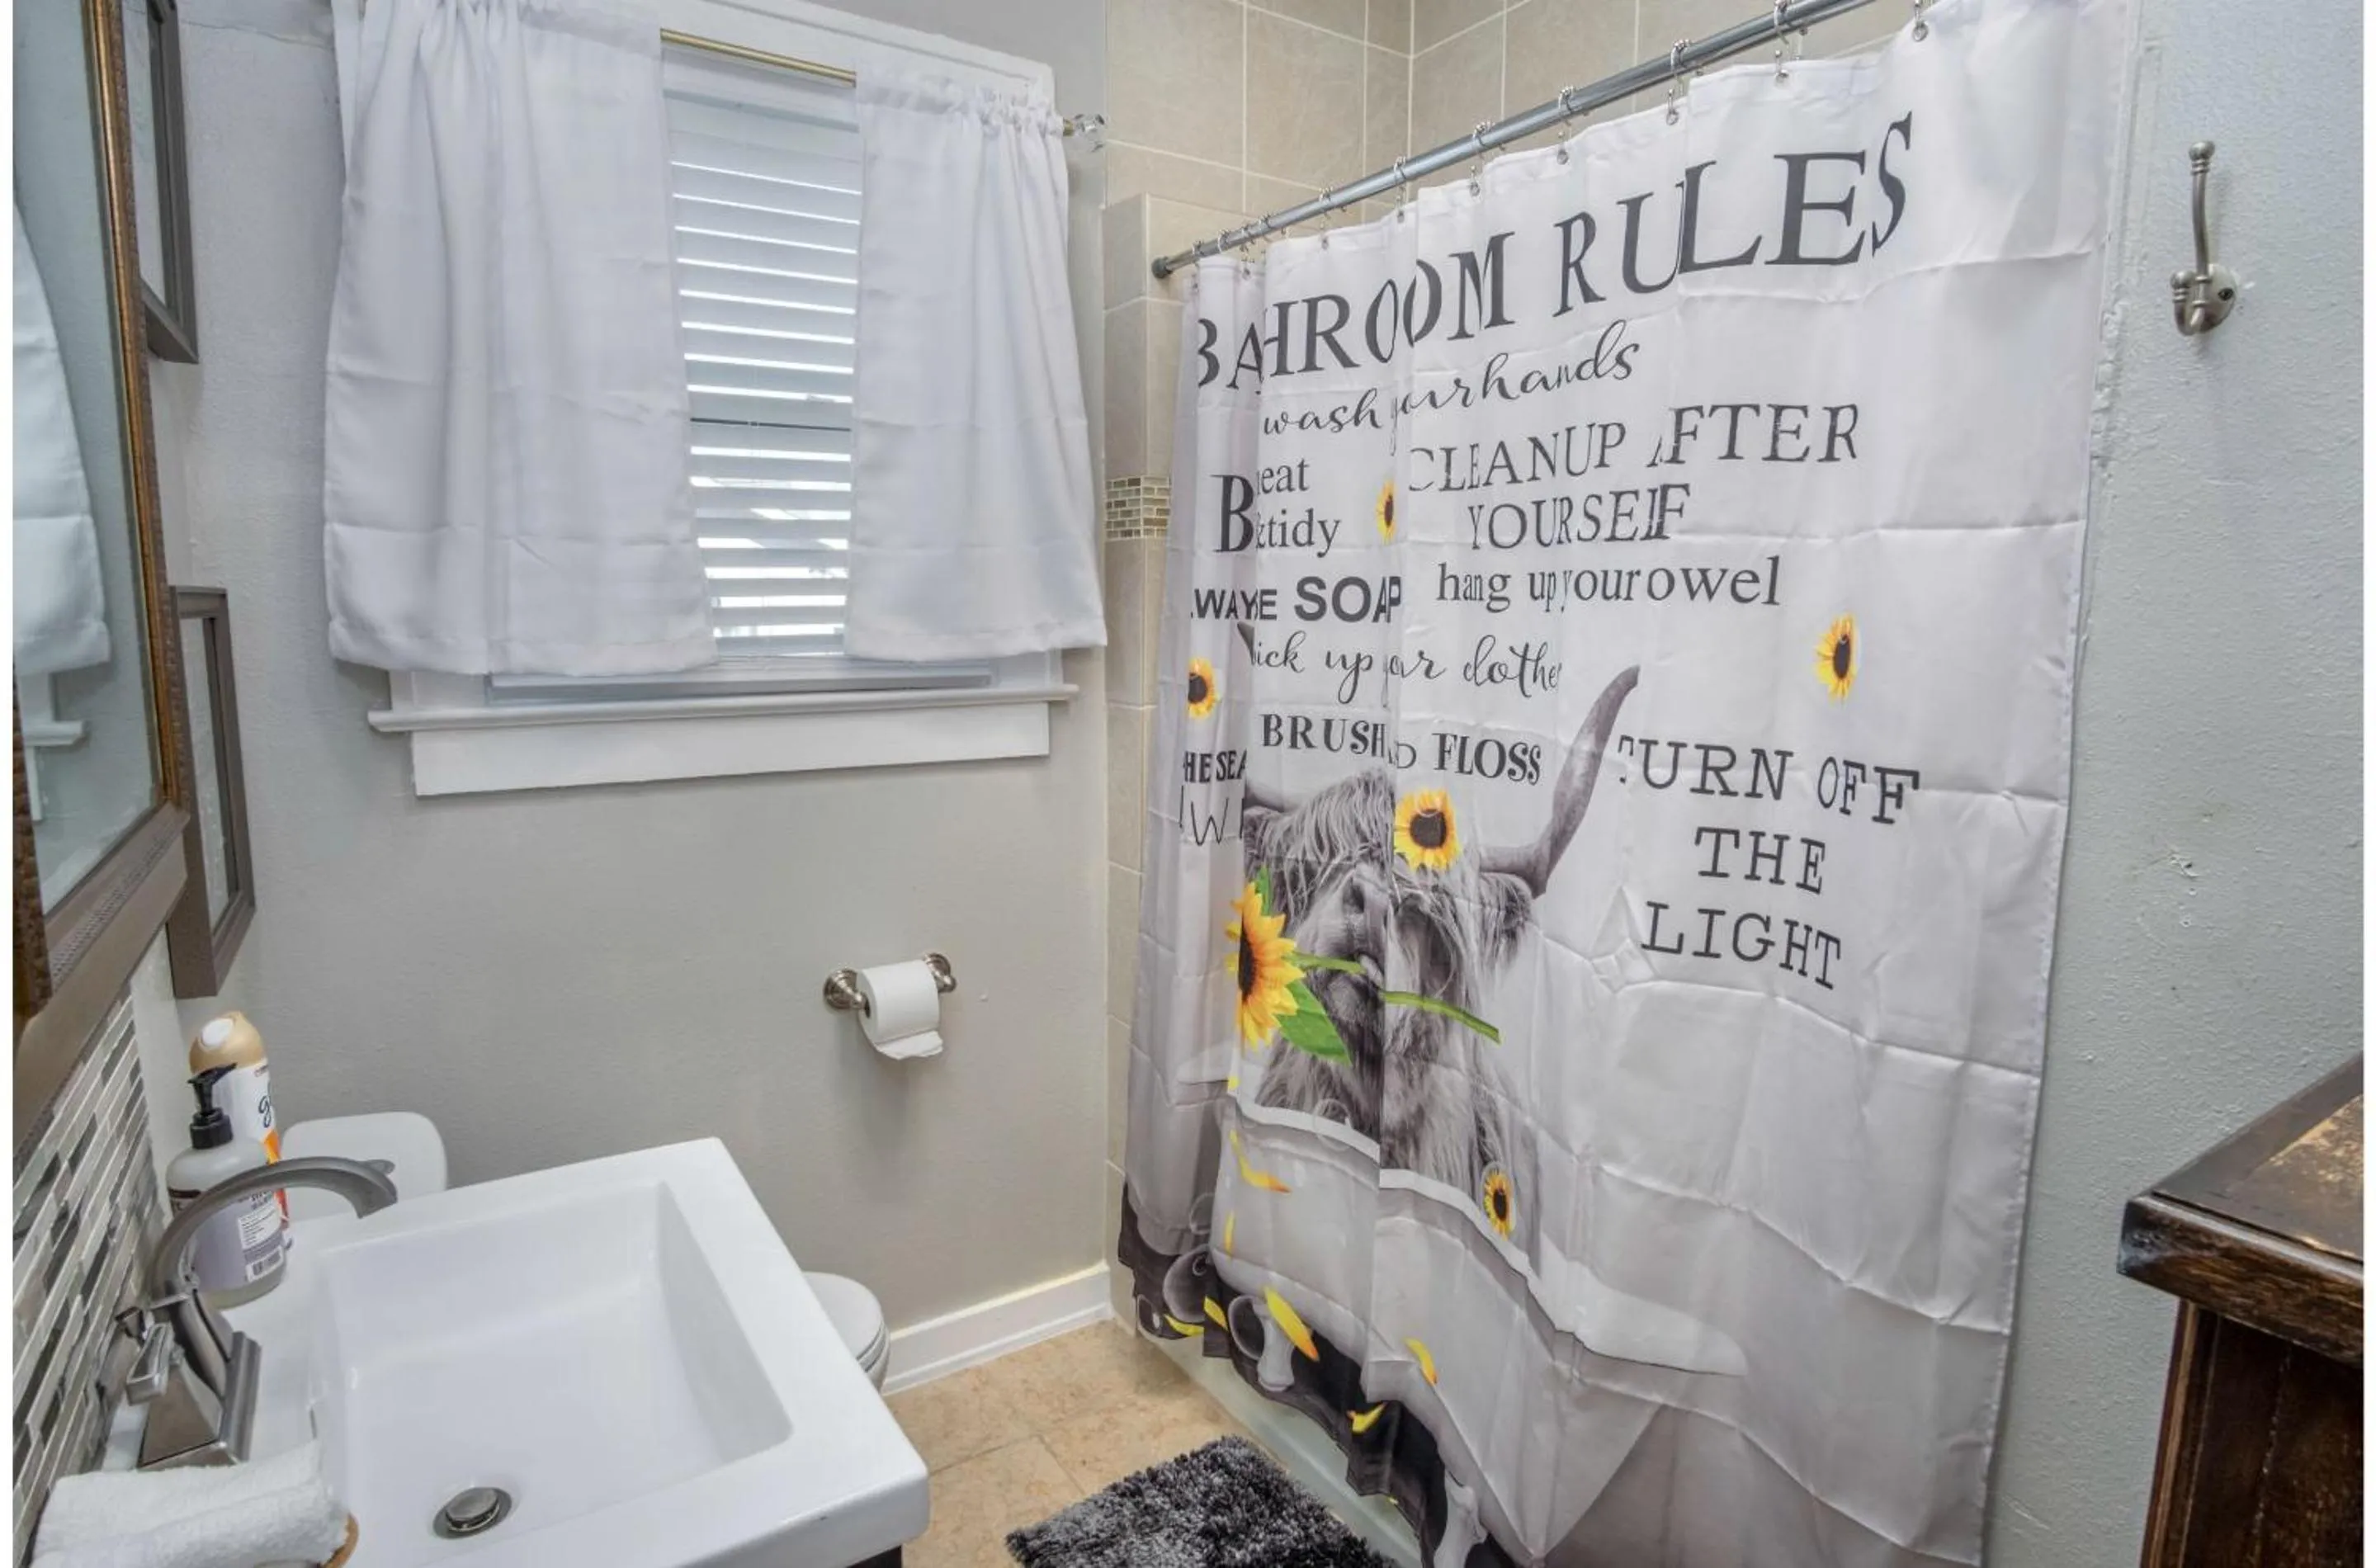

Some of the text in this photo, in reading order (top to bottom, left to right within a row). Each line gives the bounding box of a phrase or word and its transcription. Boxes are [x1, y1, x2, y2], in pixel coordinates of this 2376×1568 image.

[1552, 111, 1912, 317] RULES
[1264, 387, 1383, 436] wash
[1481, 319, 1640, 400] hands
[1256, 457, 1311, 495] eat
[1268, 507, 1342, 558] tidy
[1292, 575, 1402, 624] SOAP
[1436, 560, 1512, 613] hang
[1646, 555, 1781, 606] owel
[1254, 630, 1307, 673] ick
[1325, 649, 1373, 705] up
[1260, 713, 1386, 758] BRUSH
[1432, 732, 1542, 786] FLOSS
[1817, 756, 1920, 824] OFF
[1694, 826, 1826, 895] THE
[1641, 900, 1841, 990] LIGHT
